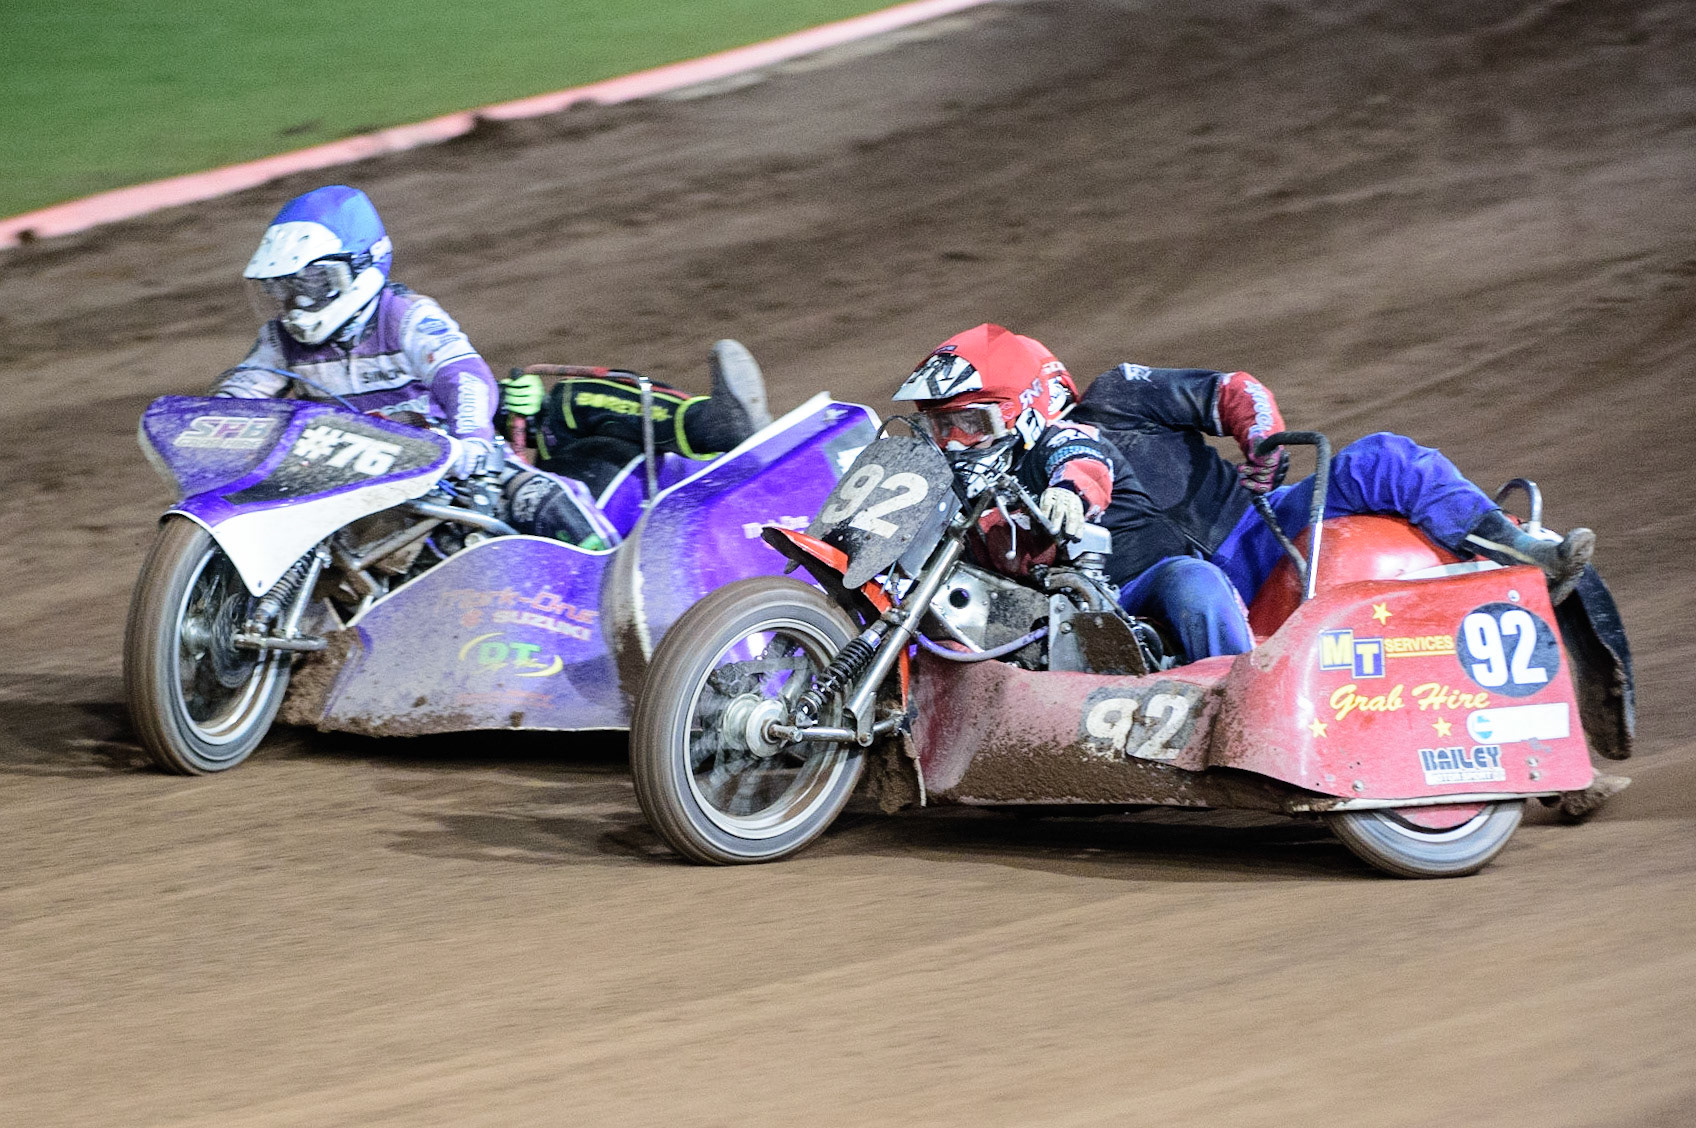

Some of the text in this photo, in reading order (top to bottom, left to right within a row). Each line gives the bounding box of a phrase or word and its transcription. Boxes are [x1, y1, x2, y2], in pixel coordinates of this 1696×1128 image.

[292, 425, 403, 476] #76
[821, 463, 929, 539] 92
[1320, 631, 1455, 677] MT SERVICES
[1463, 609, 1549, 687] 92
[1329, 682, 1491, 721] Grab Hire
[1081, 693, 1190, 762] 92
[1420, 746, 1499, 771] BAILEY
